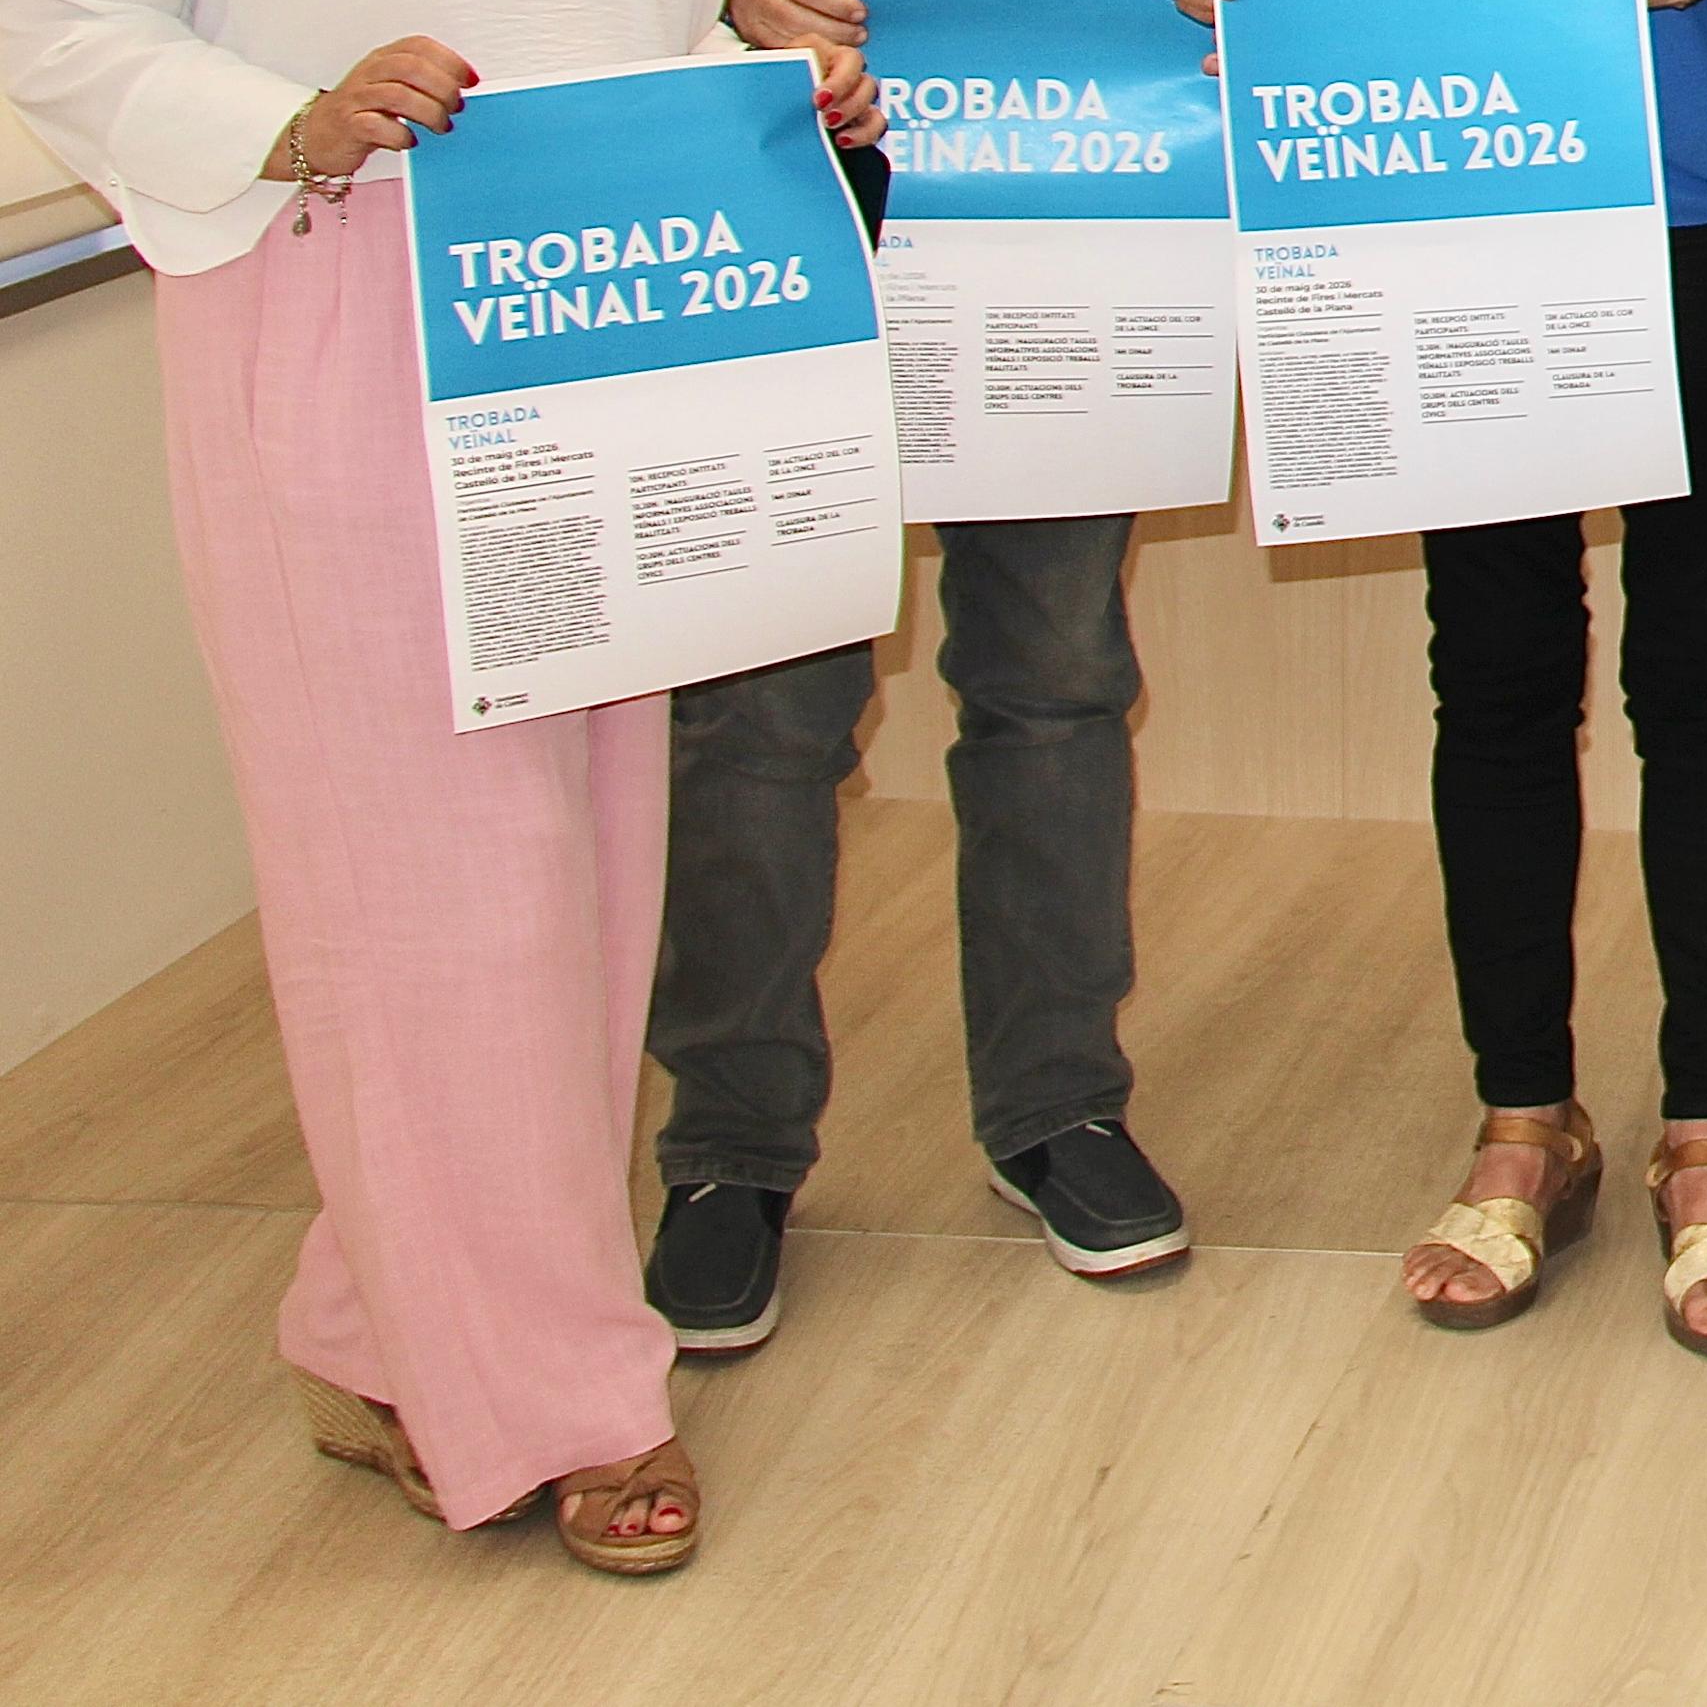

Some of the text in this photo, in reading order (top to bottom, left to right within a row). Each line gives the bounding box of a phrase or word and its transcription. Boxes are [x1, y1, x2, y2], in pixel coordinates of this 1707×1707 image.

[880, 77, 1109, 121] ROBADA
[1252, 71, 1520, 129] TROBADA
[886, 119, 1170, 173] EÏNAL 2026
[1257, 120, 1587, 182] VEÏNAL 2026
[448, 211, 743, 288] TROBADA
[1254, 245, 1338, 260] TROBADA
[453, 278, 664, 345] VEÏNAL
[680, 256, 810, 316] 2026
[446, 408, 540, 430] TROBADA
[453, 466, 496, 477] Recinte
[550, 451, 595, 463] Mercats
[467, 456, 482, 464] de
[484, 451, 513, 461] maig
[515, 449, 530, 457] de
[501, 475, 516, 483] de
[531, 469, 562, 478] Plana
